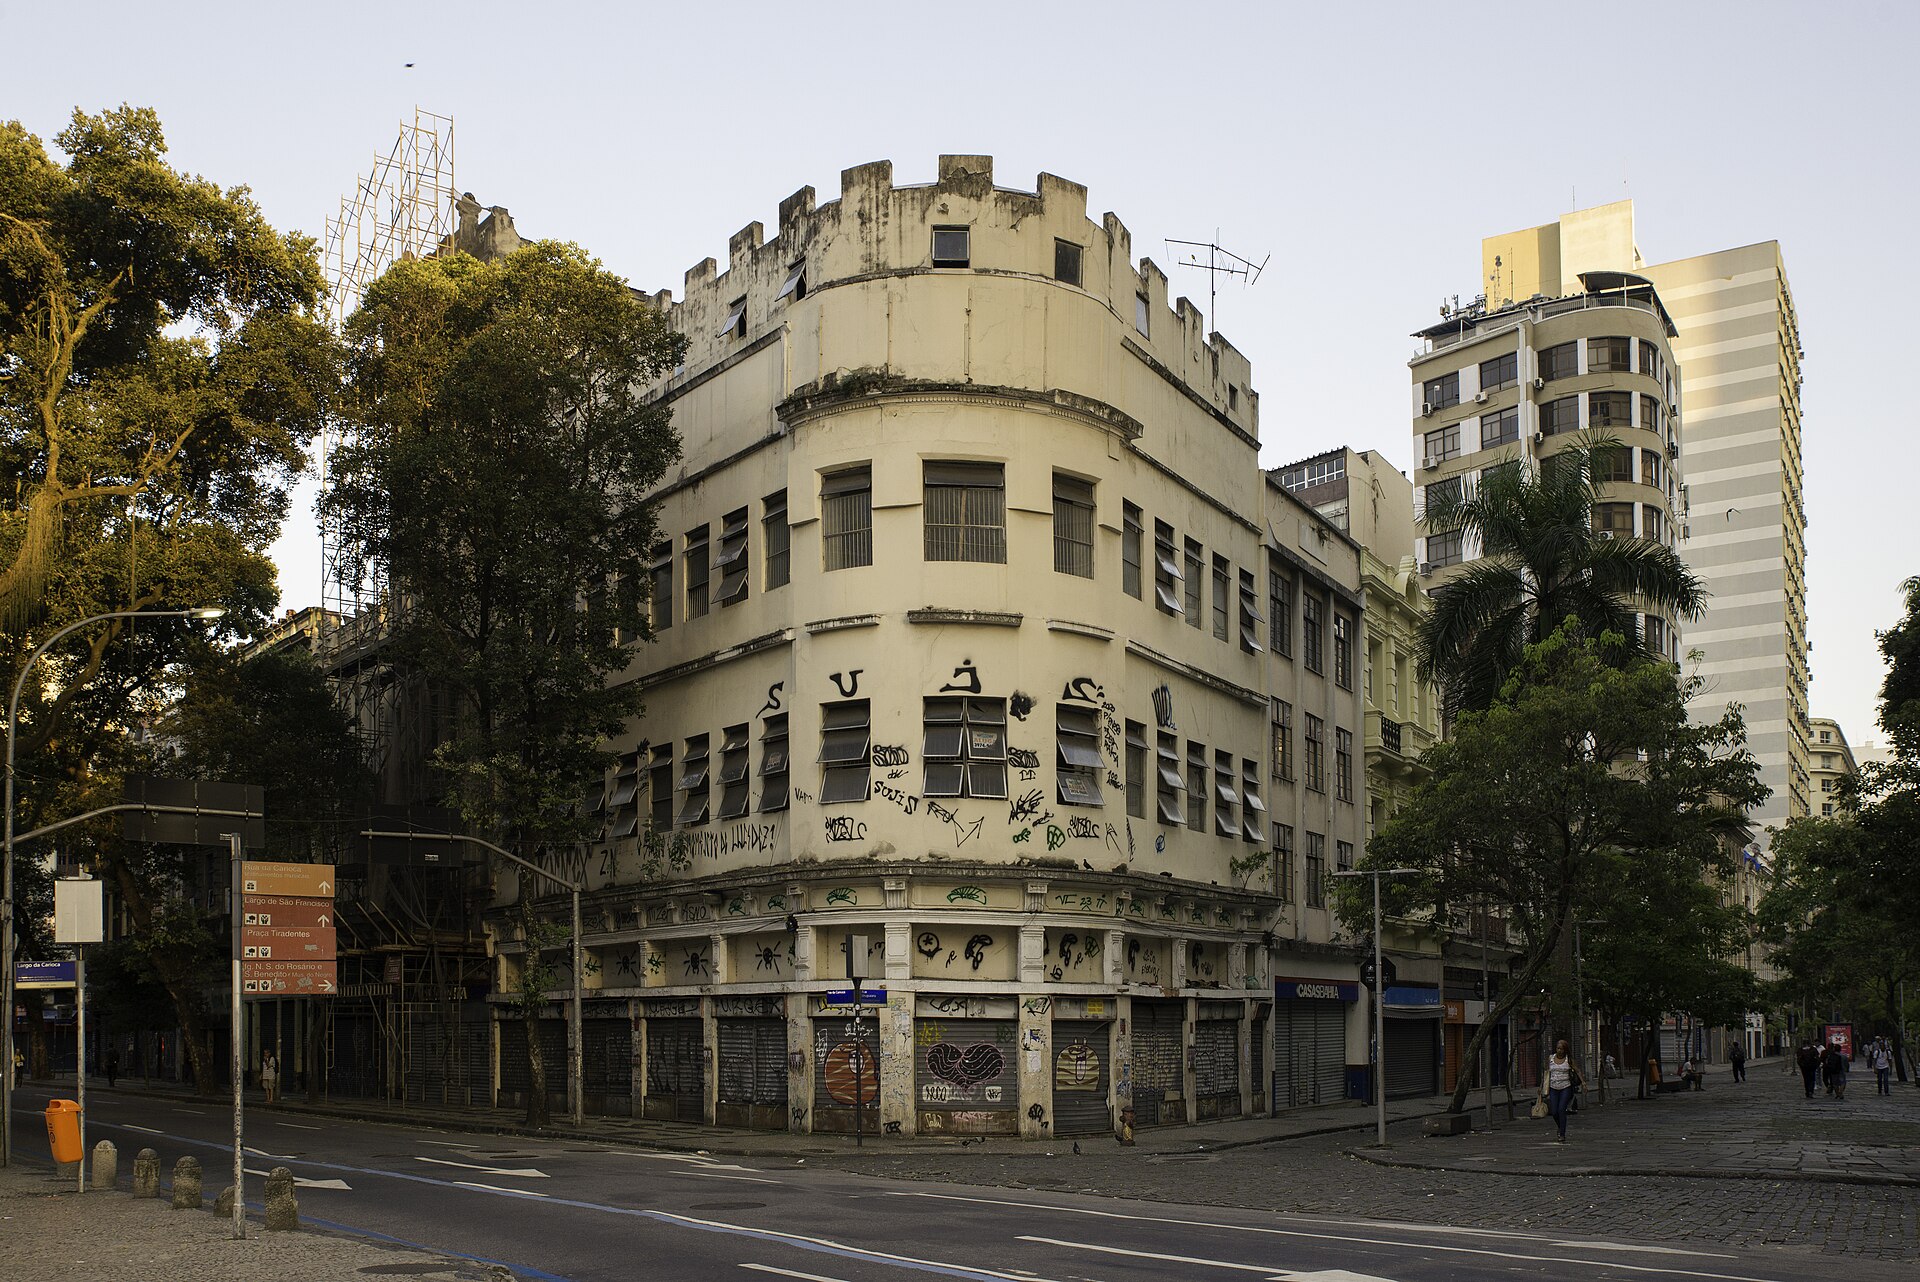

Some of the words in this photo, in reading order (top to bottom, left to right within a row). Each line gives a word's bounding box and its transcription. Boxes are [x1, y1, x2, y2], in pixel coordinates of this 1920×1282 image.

[244, 863, 260, 871] Rua
[273, 864, 302, 873] Carioca
[244, 897, 266, 906] Largo
[279, 898, 294, 906] São
[295, 899, 330, 908] Francisco
[247, 929, 269, 938] Praça
[271, 929, 311, 938] Tiradentes
[244, 963, 254, 971] Ig.
[244, 970, 253, 978] S.
[254, 970, 287, 978] Benedito
